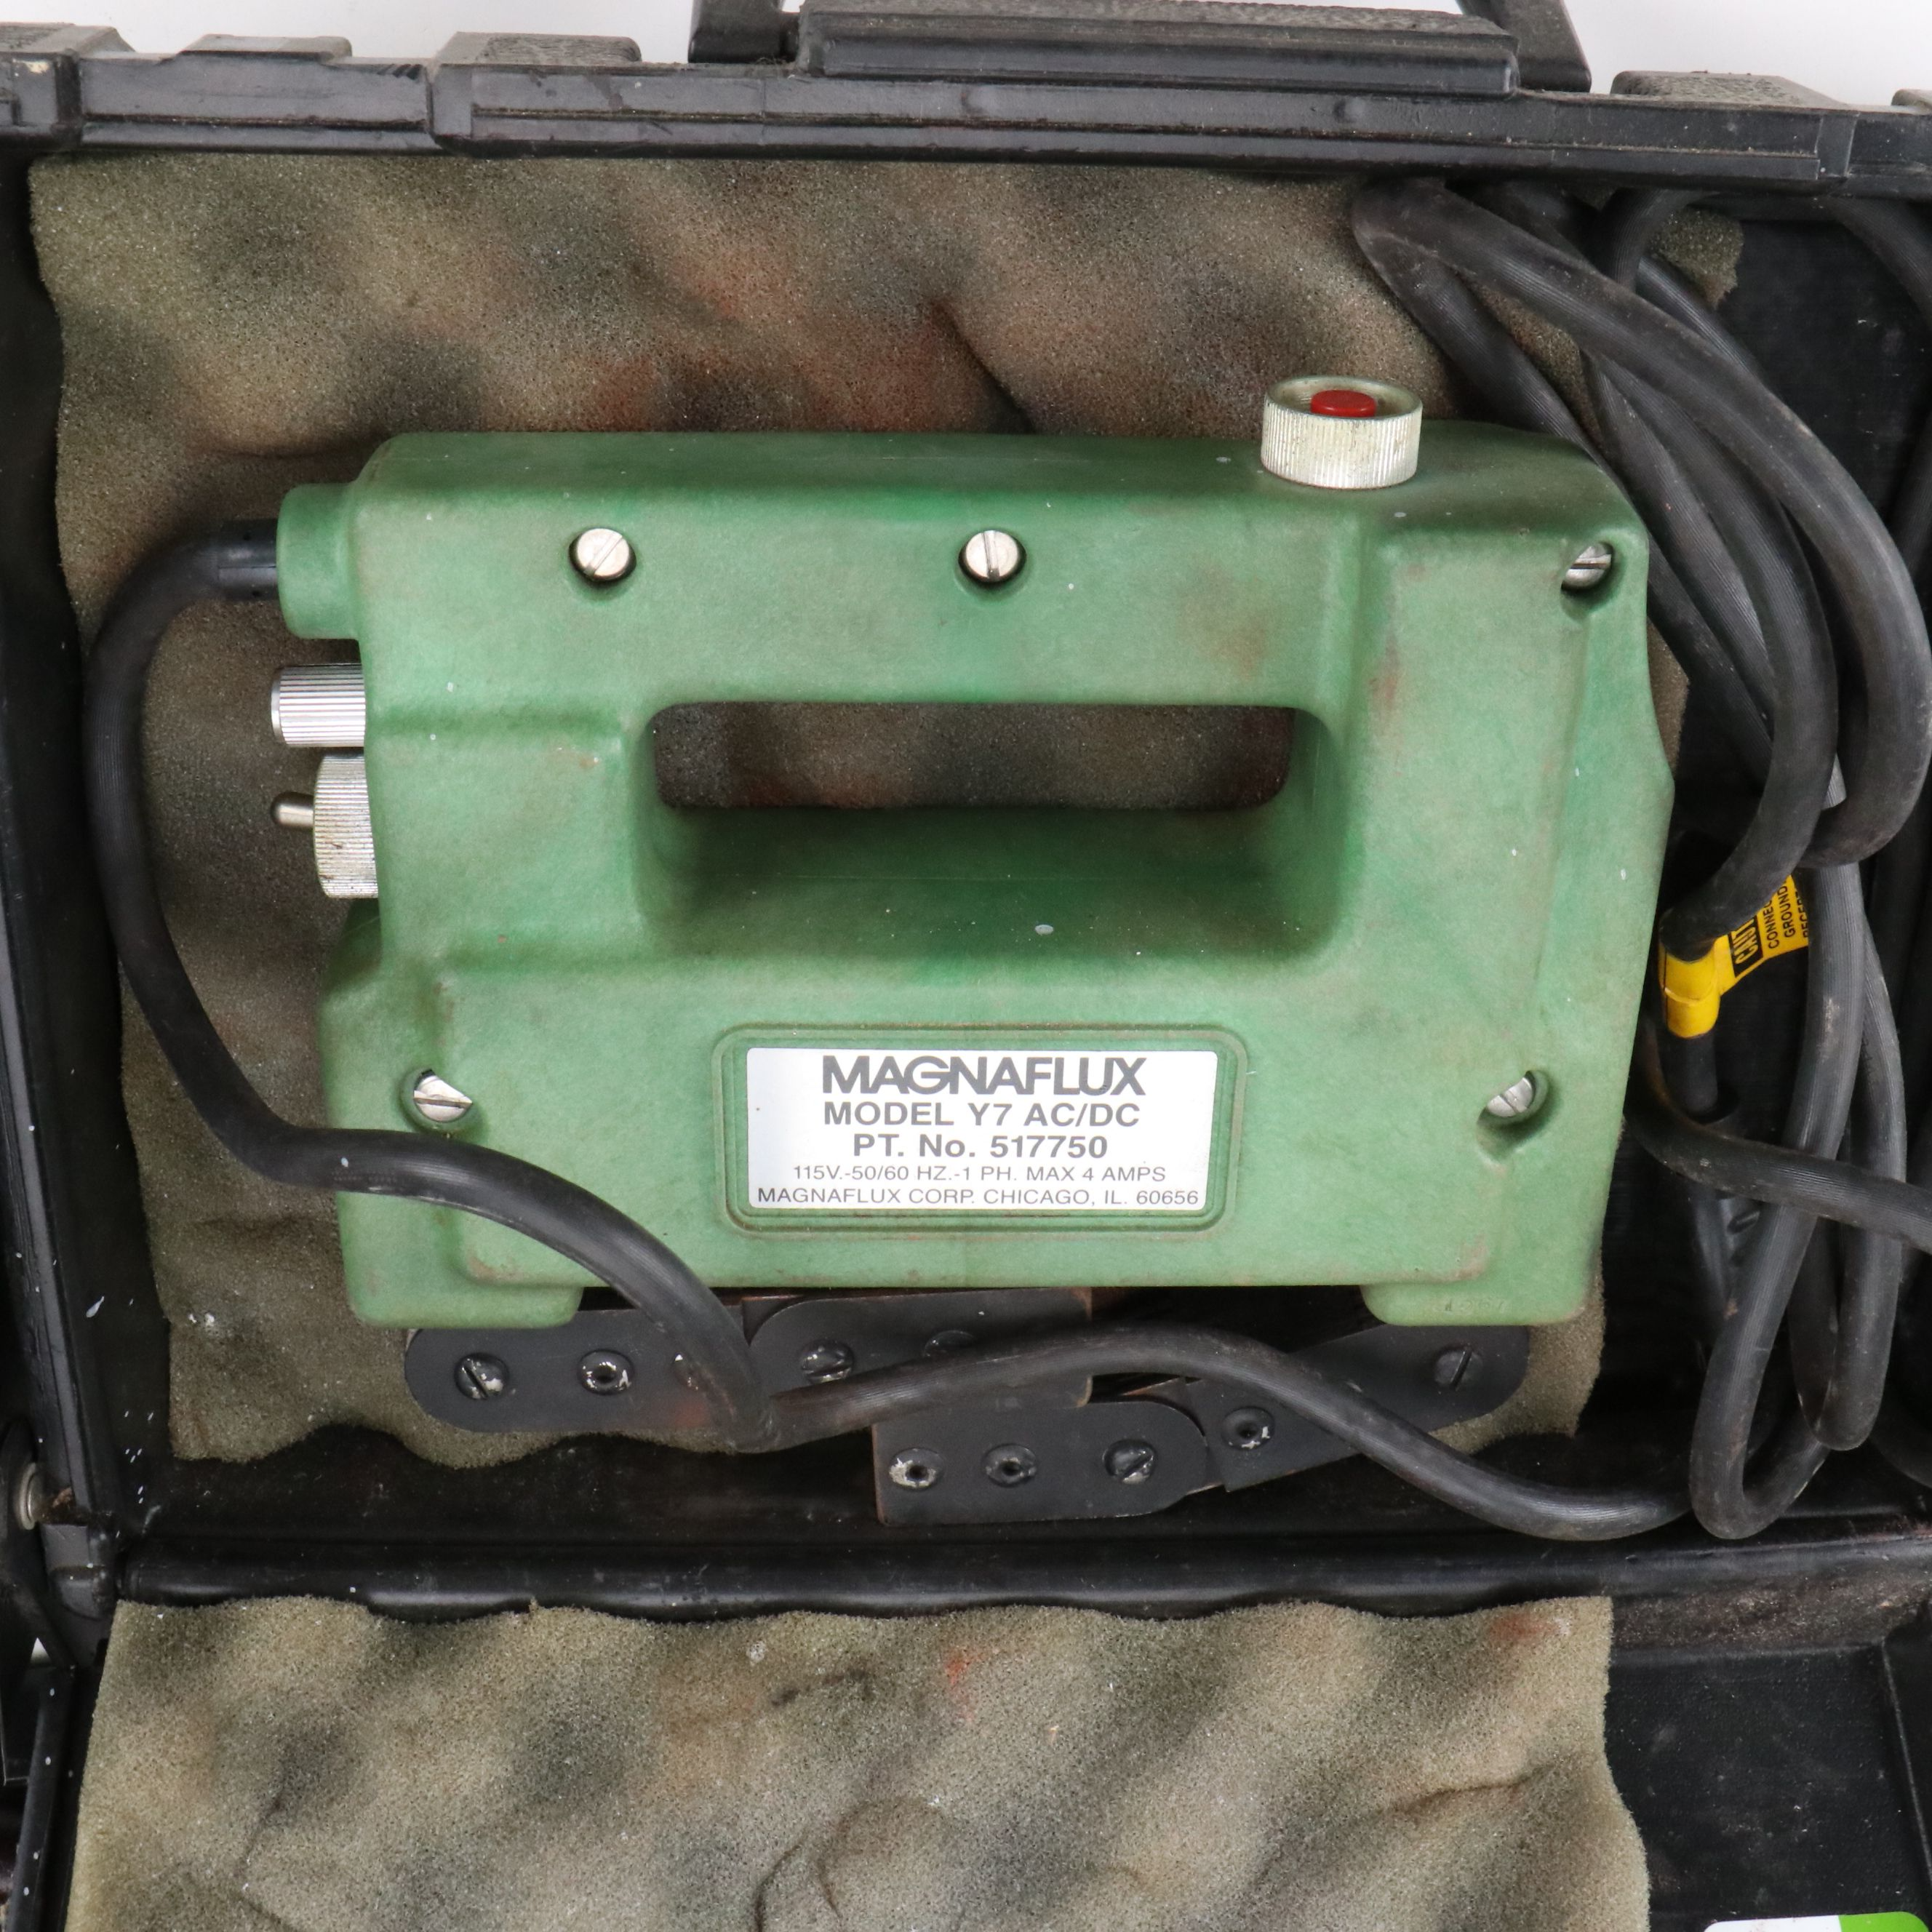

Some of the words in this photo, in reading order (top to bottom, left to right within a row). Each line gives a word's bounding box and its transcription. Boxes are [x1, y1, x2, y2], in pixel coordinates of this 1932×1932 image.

[1776, 880, 1796, 938] GROUND
[1731, 918, 1759, 965] CAUT
[823, 1055, 1147, 1096] MAGNAFLUX
[824, 1101, 954, 1126] MODEL
[967, 1103, 1013, 1126] Y7
[1023, 1103, 1140, 1127] AC/DC
[854, 1133, 906, 1157] PT.
[919, 1134, 975, 1157] No.
[990, 1135, 1108, 1159] 517750
[794, 1165, 909, 1180] 115V.-50/60
[981, 1166, 1017, 1181] PH.
[1026, 1166, 1074, 1181] MAX
[1082, 1167, 1093, 1181] 4
[1101, 1167, 1165, 1182] AMPS
[757, 1187, 901, 1203] MAGNAFLUX
[909, 1189, 975, 1205] CORP.
[983, 1189, 1095, 1207] CHICAGO,
[1104, 1189, 1127, 1205] IL.
[1135, 1190, 1198, 1205] 60656
